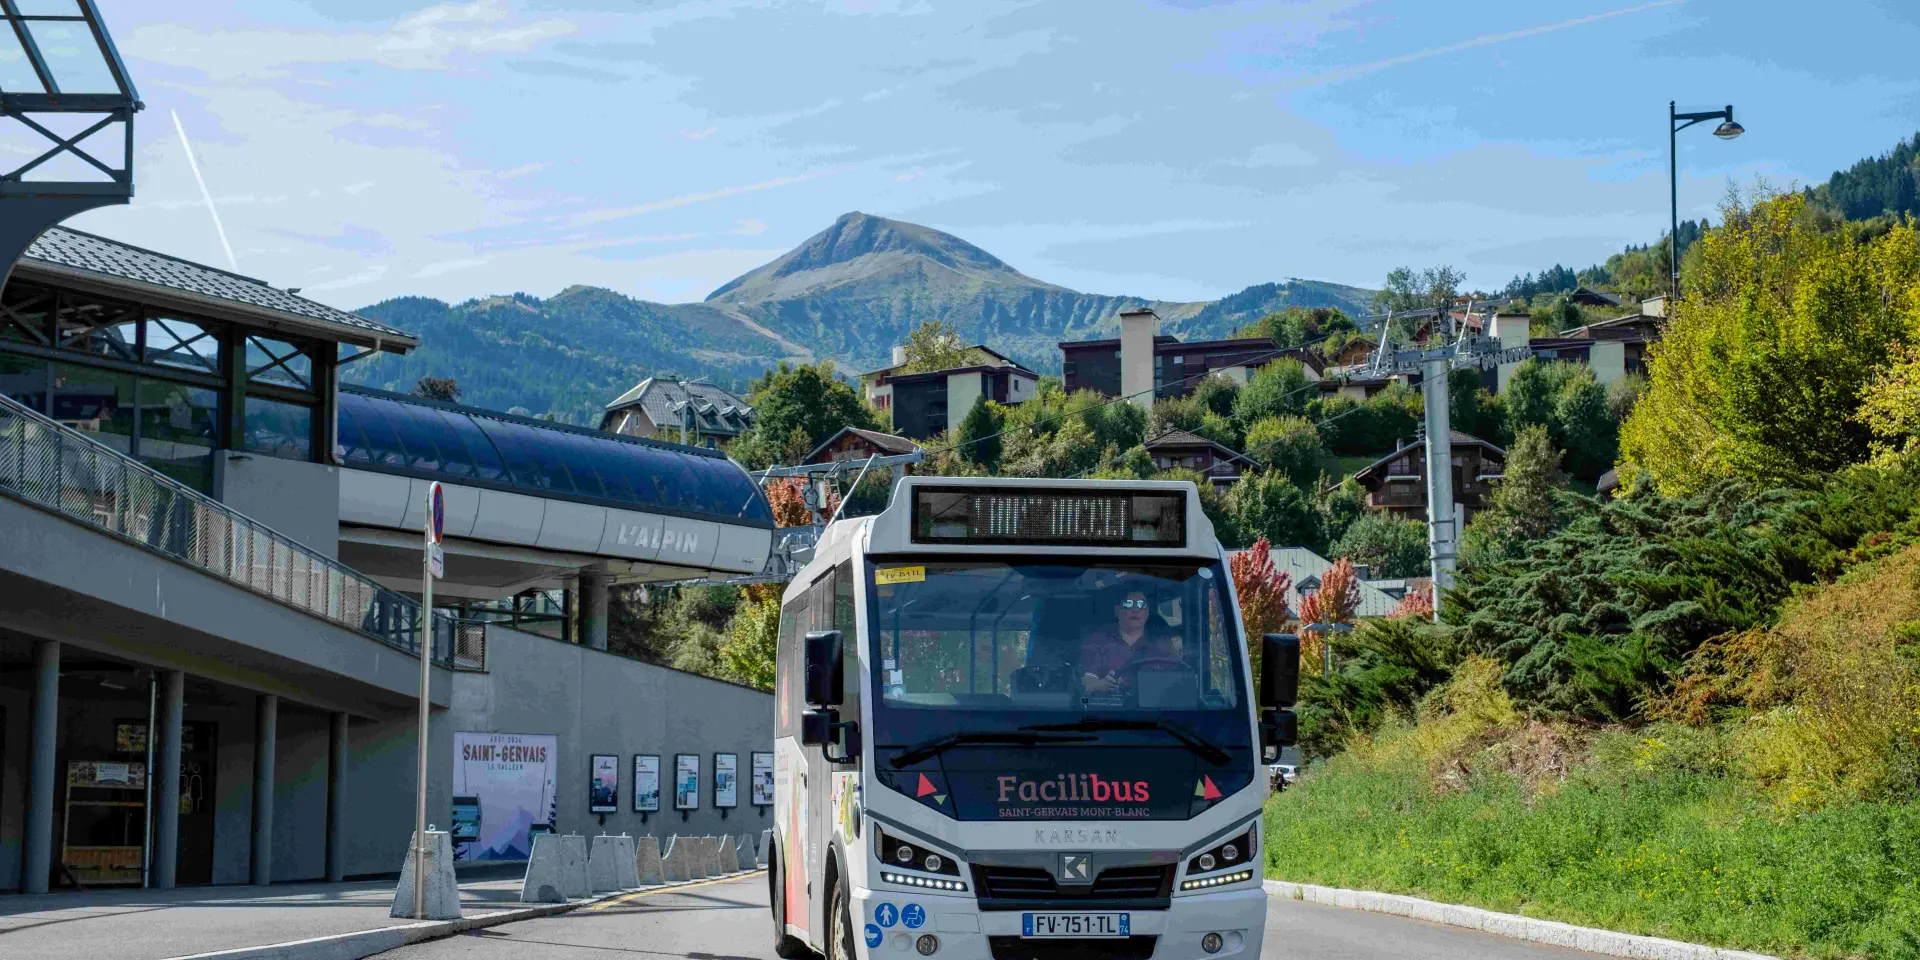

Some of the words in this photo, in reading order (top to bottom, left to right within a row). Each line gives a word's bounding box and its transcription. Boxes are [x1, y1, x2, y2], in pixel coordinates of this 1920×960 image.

[618, 524, 698, 553] L'ALPIN
[463, 744, 546, 763] SAINT-GERVAIS
[997, 773, 1150, 802] Facilibus
[999, 807, 1078, 817] SAINT-GERVAIS
[1080, 807, 1150, 817] MONT-BLANC
[1035, 828, 1117, 843] KARSAN
[1036, 916, 1116, 933] FV-751-TL
[1120, 925, 1129, 934] 74
